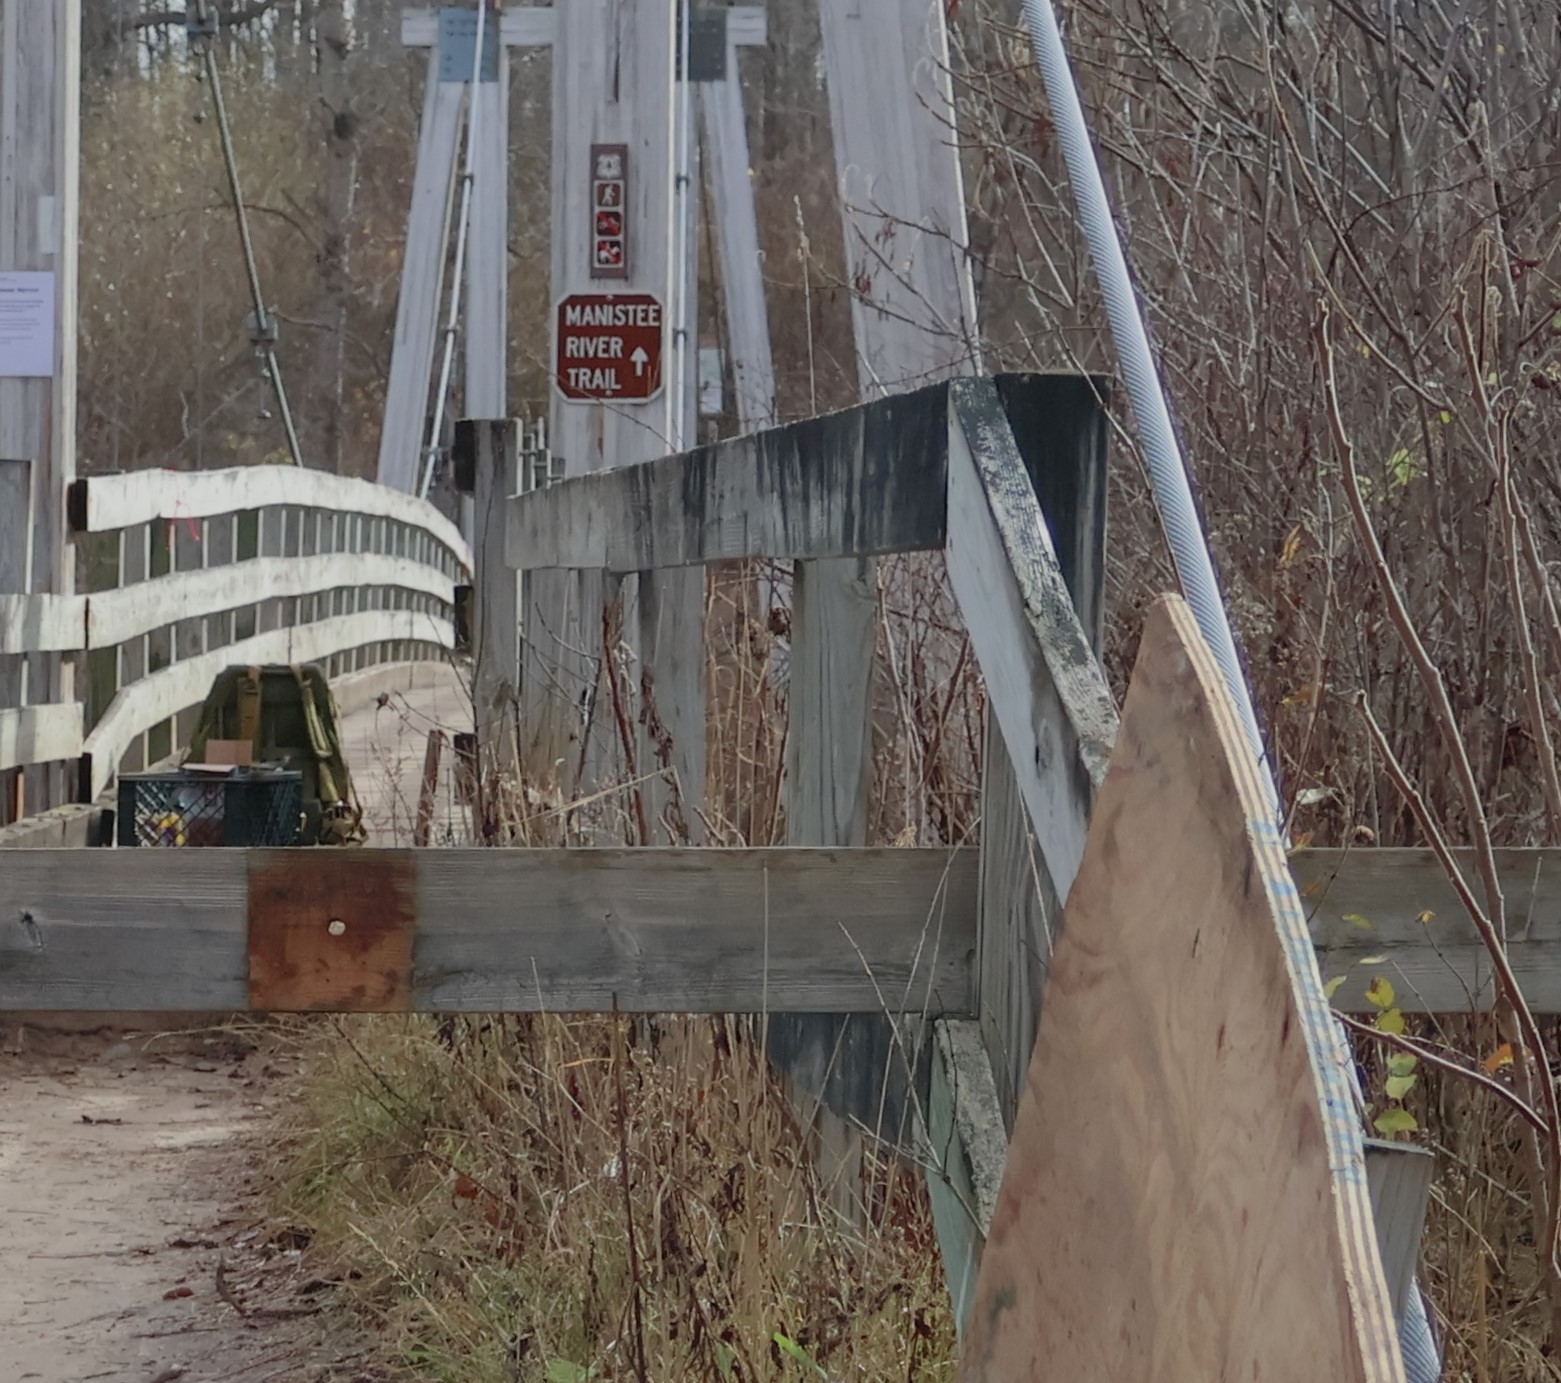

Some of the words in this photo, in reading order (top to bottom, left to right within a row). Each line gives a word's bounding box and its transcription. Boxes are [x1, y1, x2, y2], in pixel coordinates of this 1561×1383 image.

[565, 304, 660, 327] MANISTEE
[566, 336, 624, 358] RIVER
[567, 367, 622, 390] TRAIL
